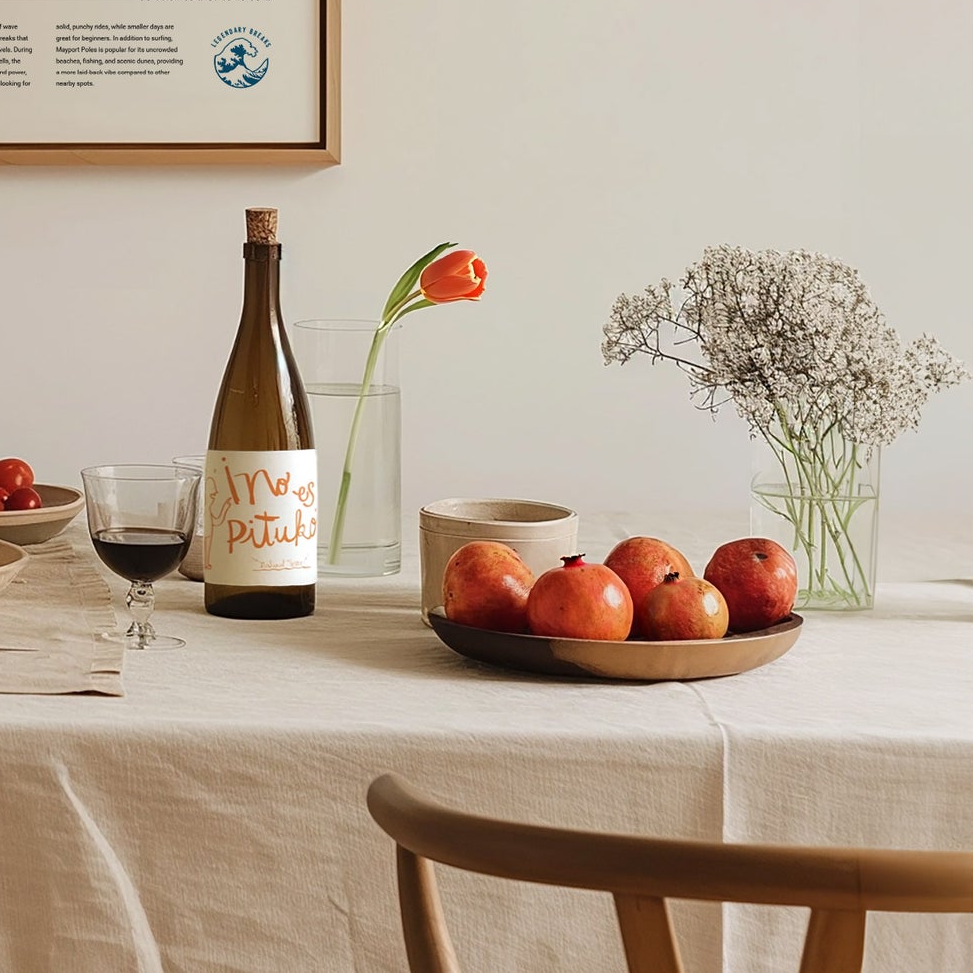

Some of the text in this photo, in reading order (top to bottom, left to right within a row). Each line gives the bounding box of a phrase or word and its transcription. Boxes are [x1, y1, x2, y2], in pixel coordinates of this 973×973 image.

[72, 23, 93, 31] punchy
[150, 23, 164, 31] days
[56, 35, 71, 43] great
[81, 35, 111, 43] beginners.
[151, 35, 173, 43] surfing,
[210, 26, 272, 48] LEGENDARY BREAKS
[13, 46, 32, 54] During
[56, 46, 80, 54] Mayport
[104, 46, 127, 54] popular
[82, 58, 103, 66] fishing,
[156, 58, 184, 66] providing
[0, 80, 21, 88] looking
[56, 80, 94, 88] nearby spots.
[292, 481, 315, 508] es
